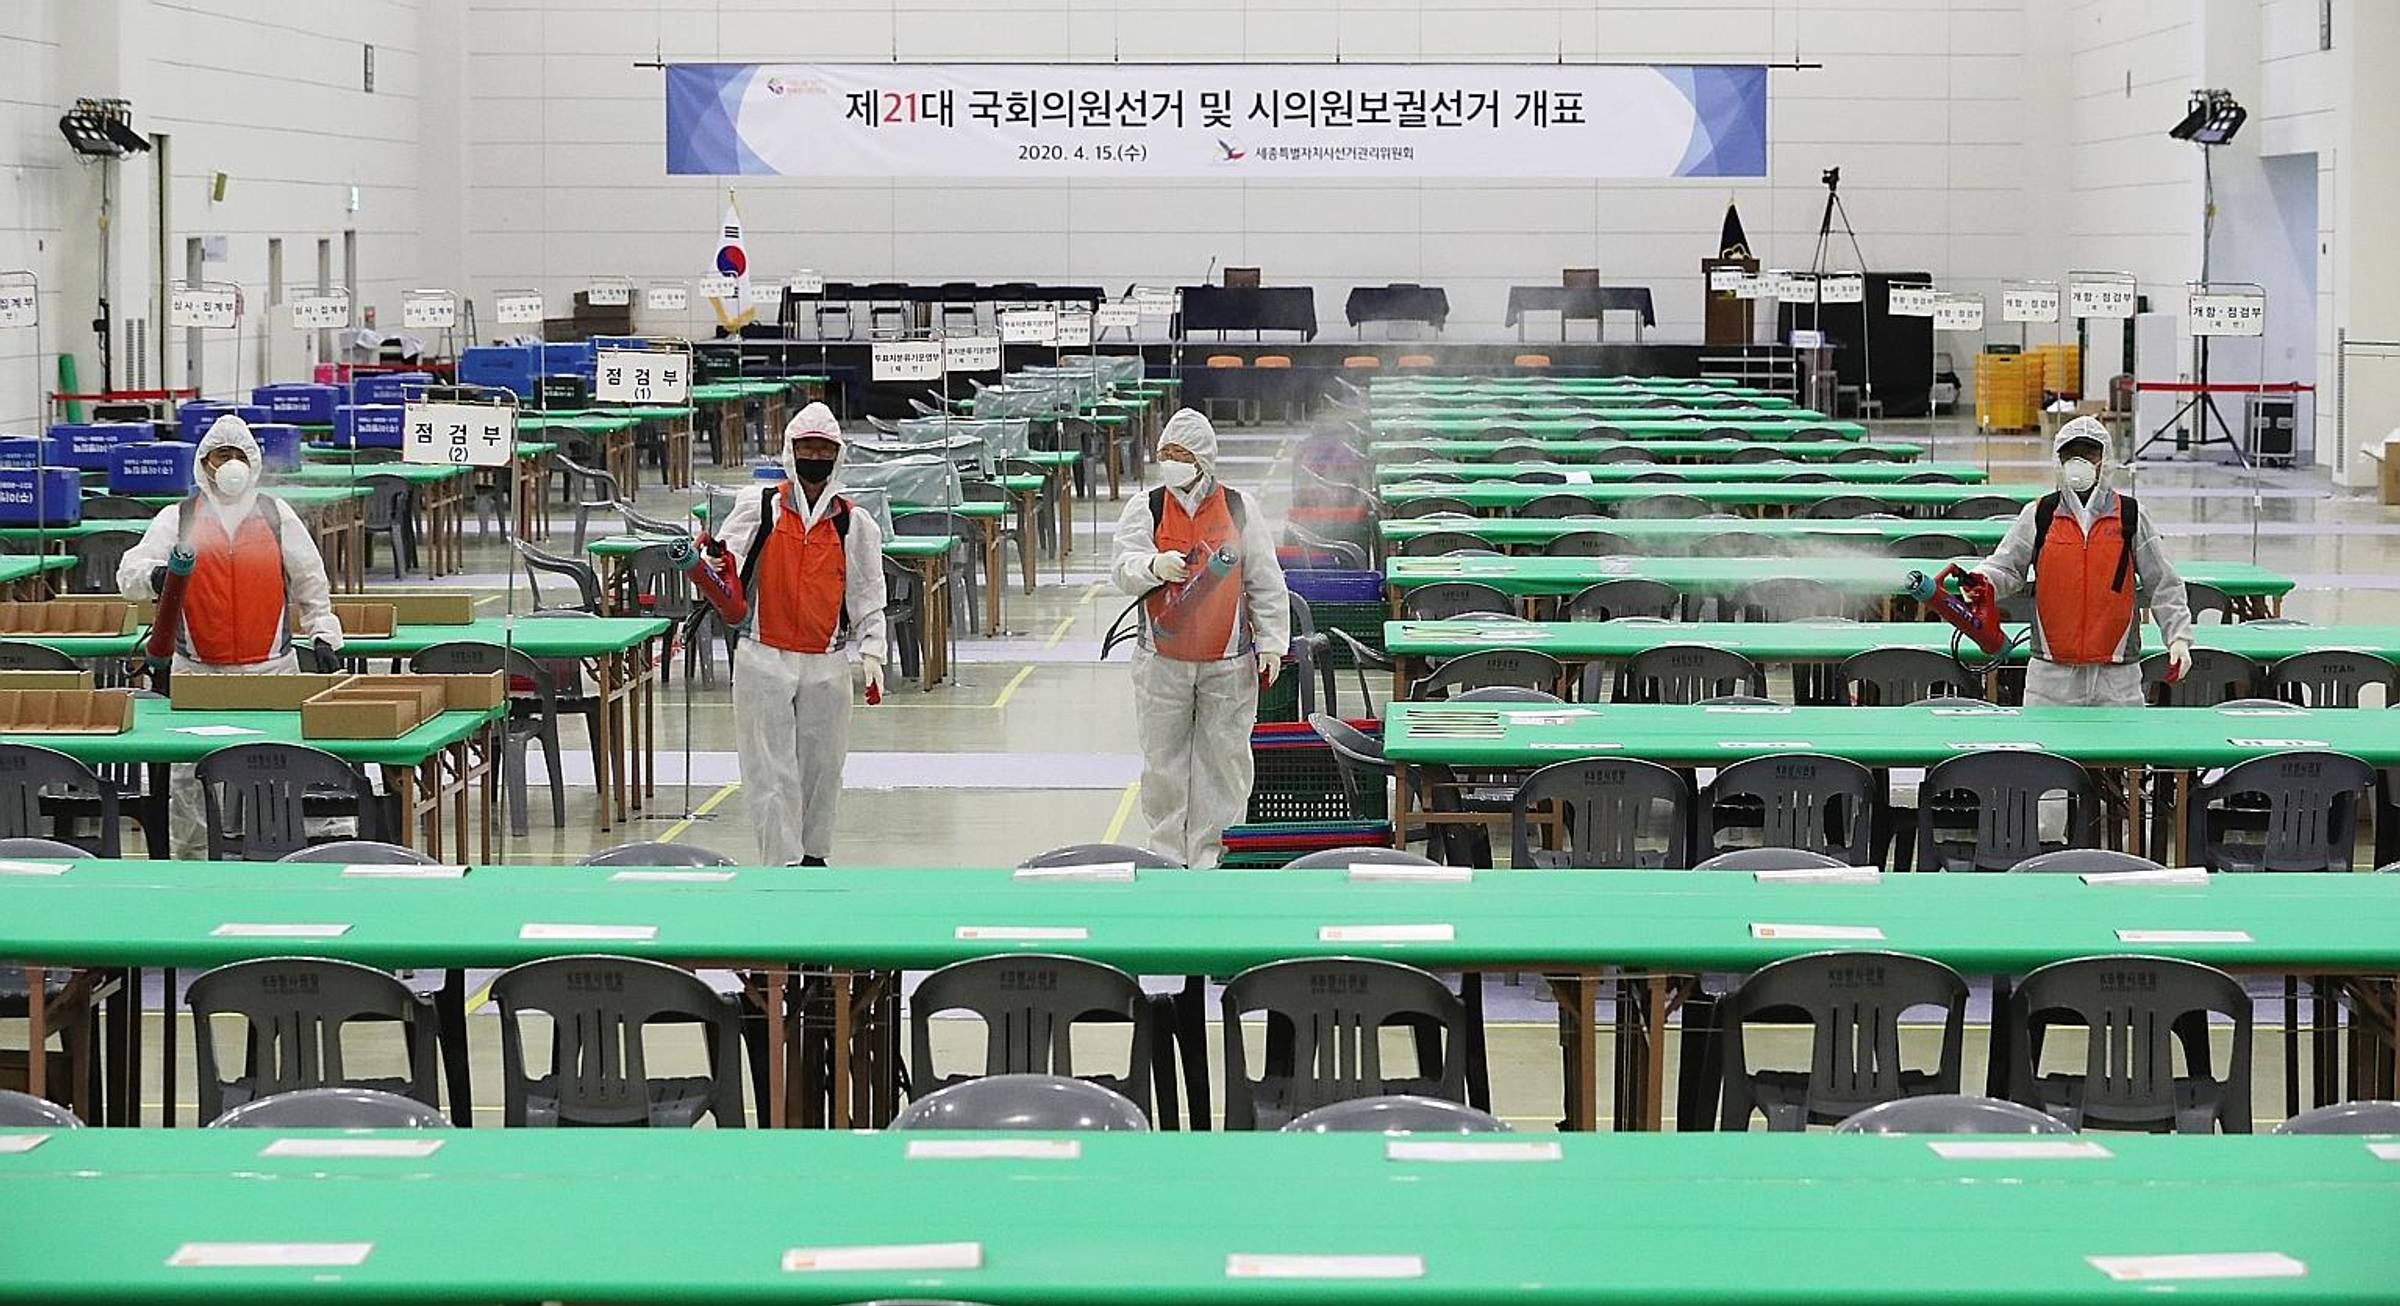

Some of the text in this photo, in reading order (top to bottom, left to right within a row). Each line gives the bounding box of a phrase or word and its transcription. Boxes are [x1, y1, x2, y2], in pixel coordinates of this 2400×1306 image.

[846, 89, 1586, 128] 제21대 국회의원선거 및 시의원보궐선거 개표
[1018, 145, 1148, 162] 2020. 4. 15.(수)
[1255, 146, 1415, 161] 세종특별자치시선거관리위원회
[2192, 306, 2262, 319] 개함·점검부
[634, 387, 652, 400] (1)
[448, 446, 469, 463] (2)
